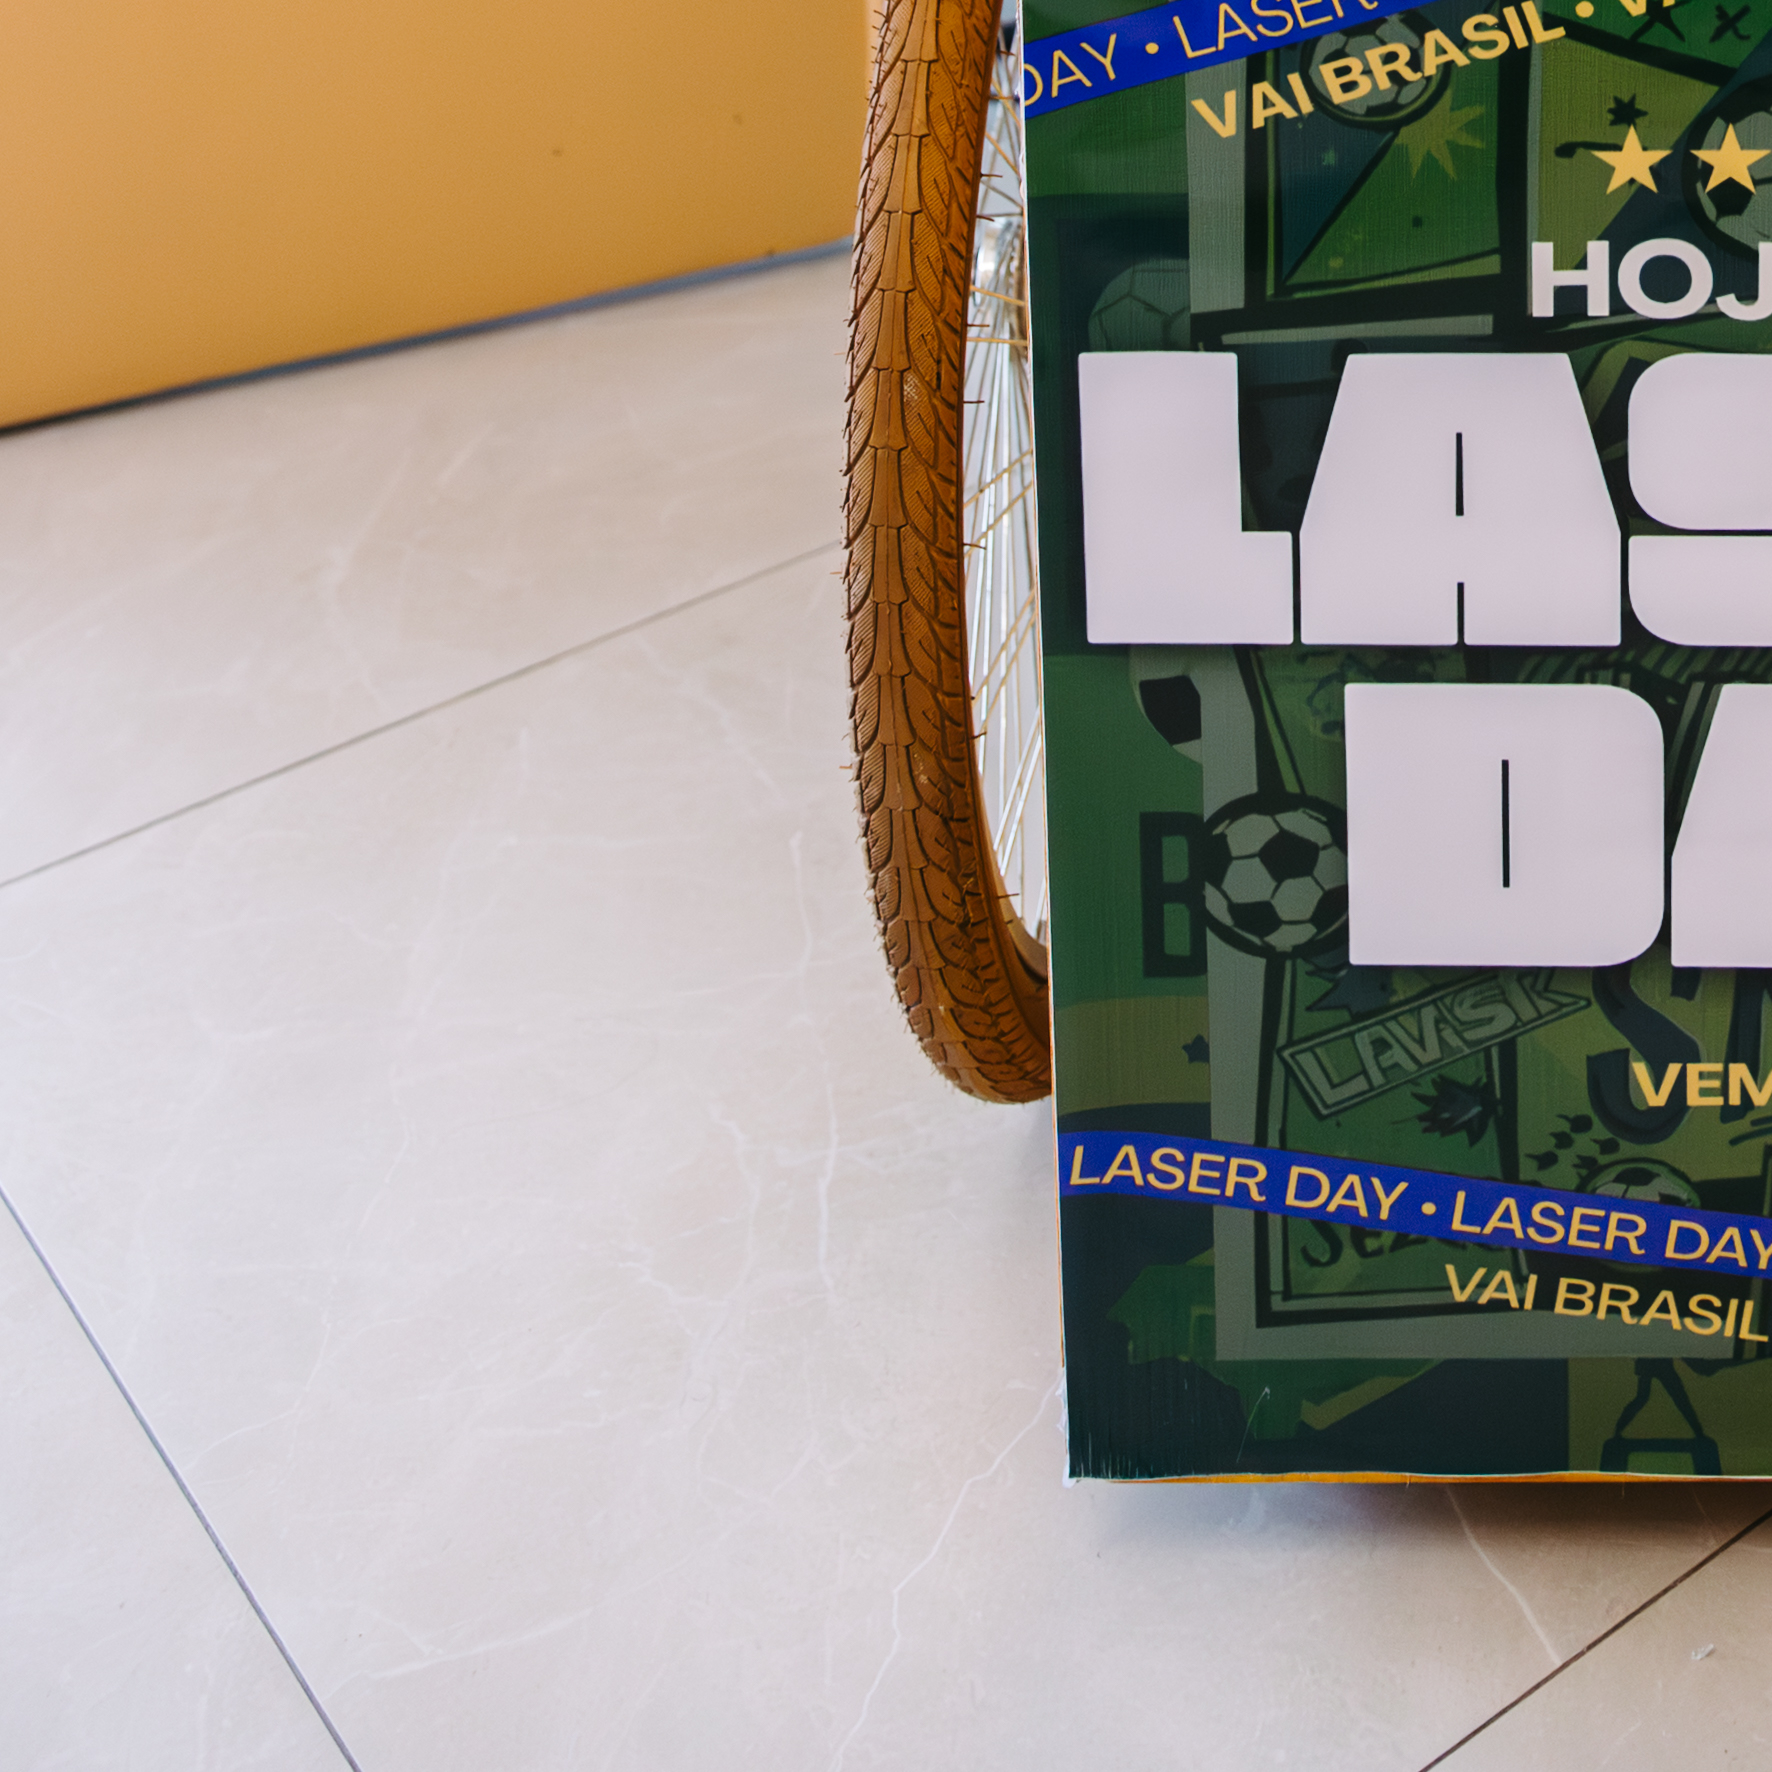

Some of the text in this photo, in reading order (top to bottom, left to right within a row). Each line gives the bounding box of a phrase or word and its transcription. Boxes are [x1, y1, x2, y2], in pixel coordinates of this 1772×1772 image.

[1024, 33, 1117, 106] DAY
[1191, 72, 1314, 138] VAI
[1320, 0, 1566, 106] BRASIL
[1069, 1144, 1266, 1202] LASER
[1284, 1165, 1408, 1221] DAY
[1451, 1190, 1646, 1255] LASER
[1444, 1264, 1537, 1311] VAI
[1553, 1277, 1769, 1342] BRASIL
